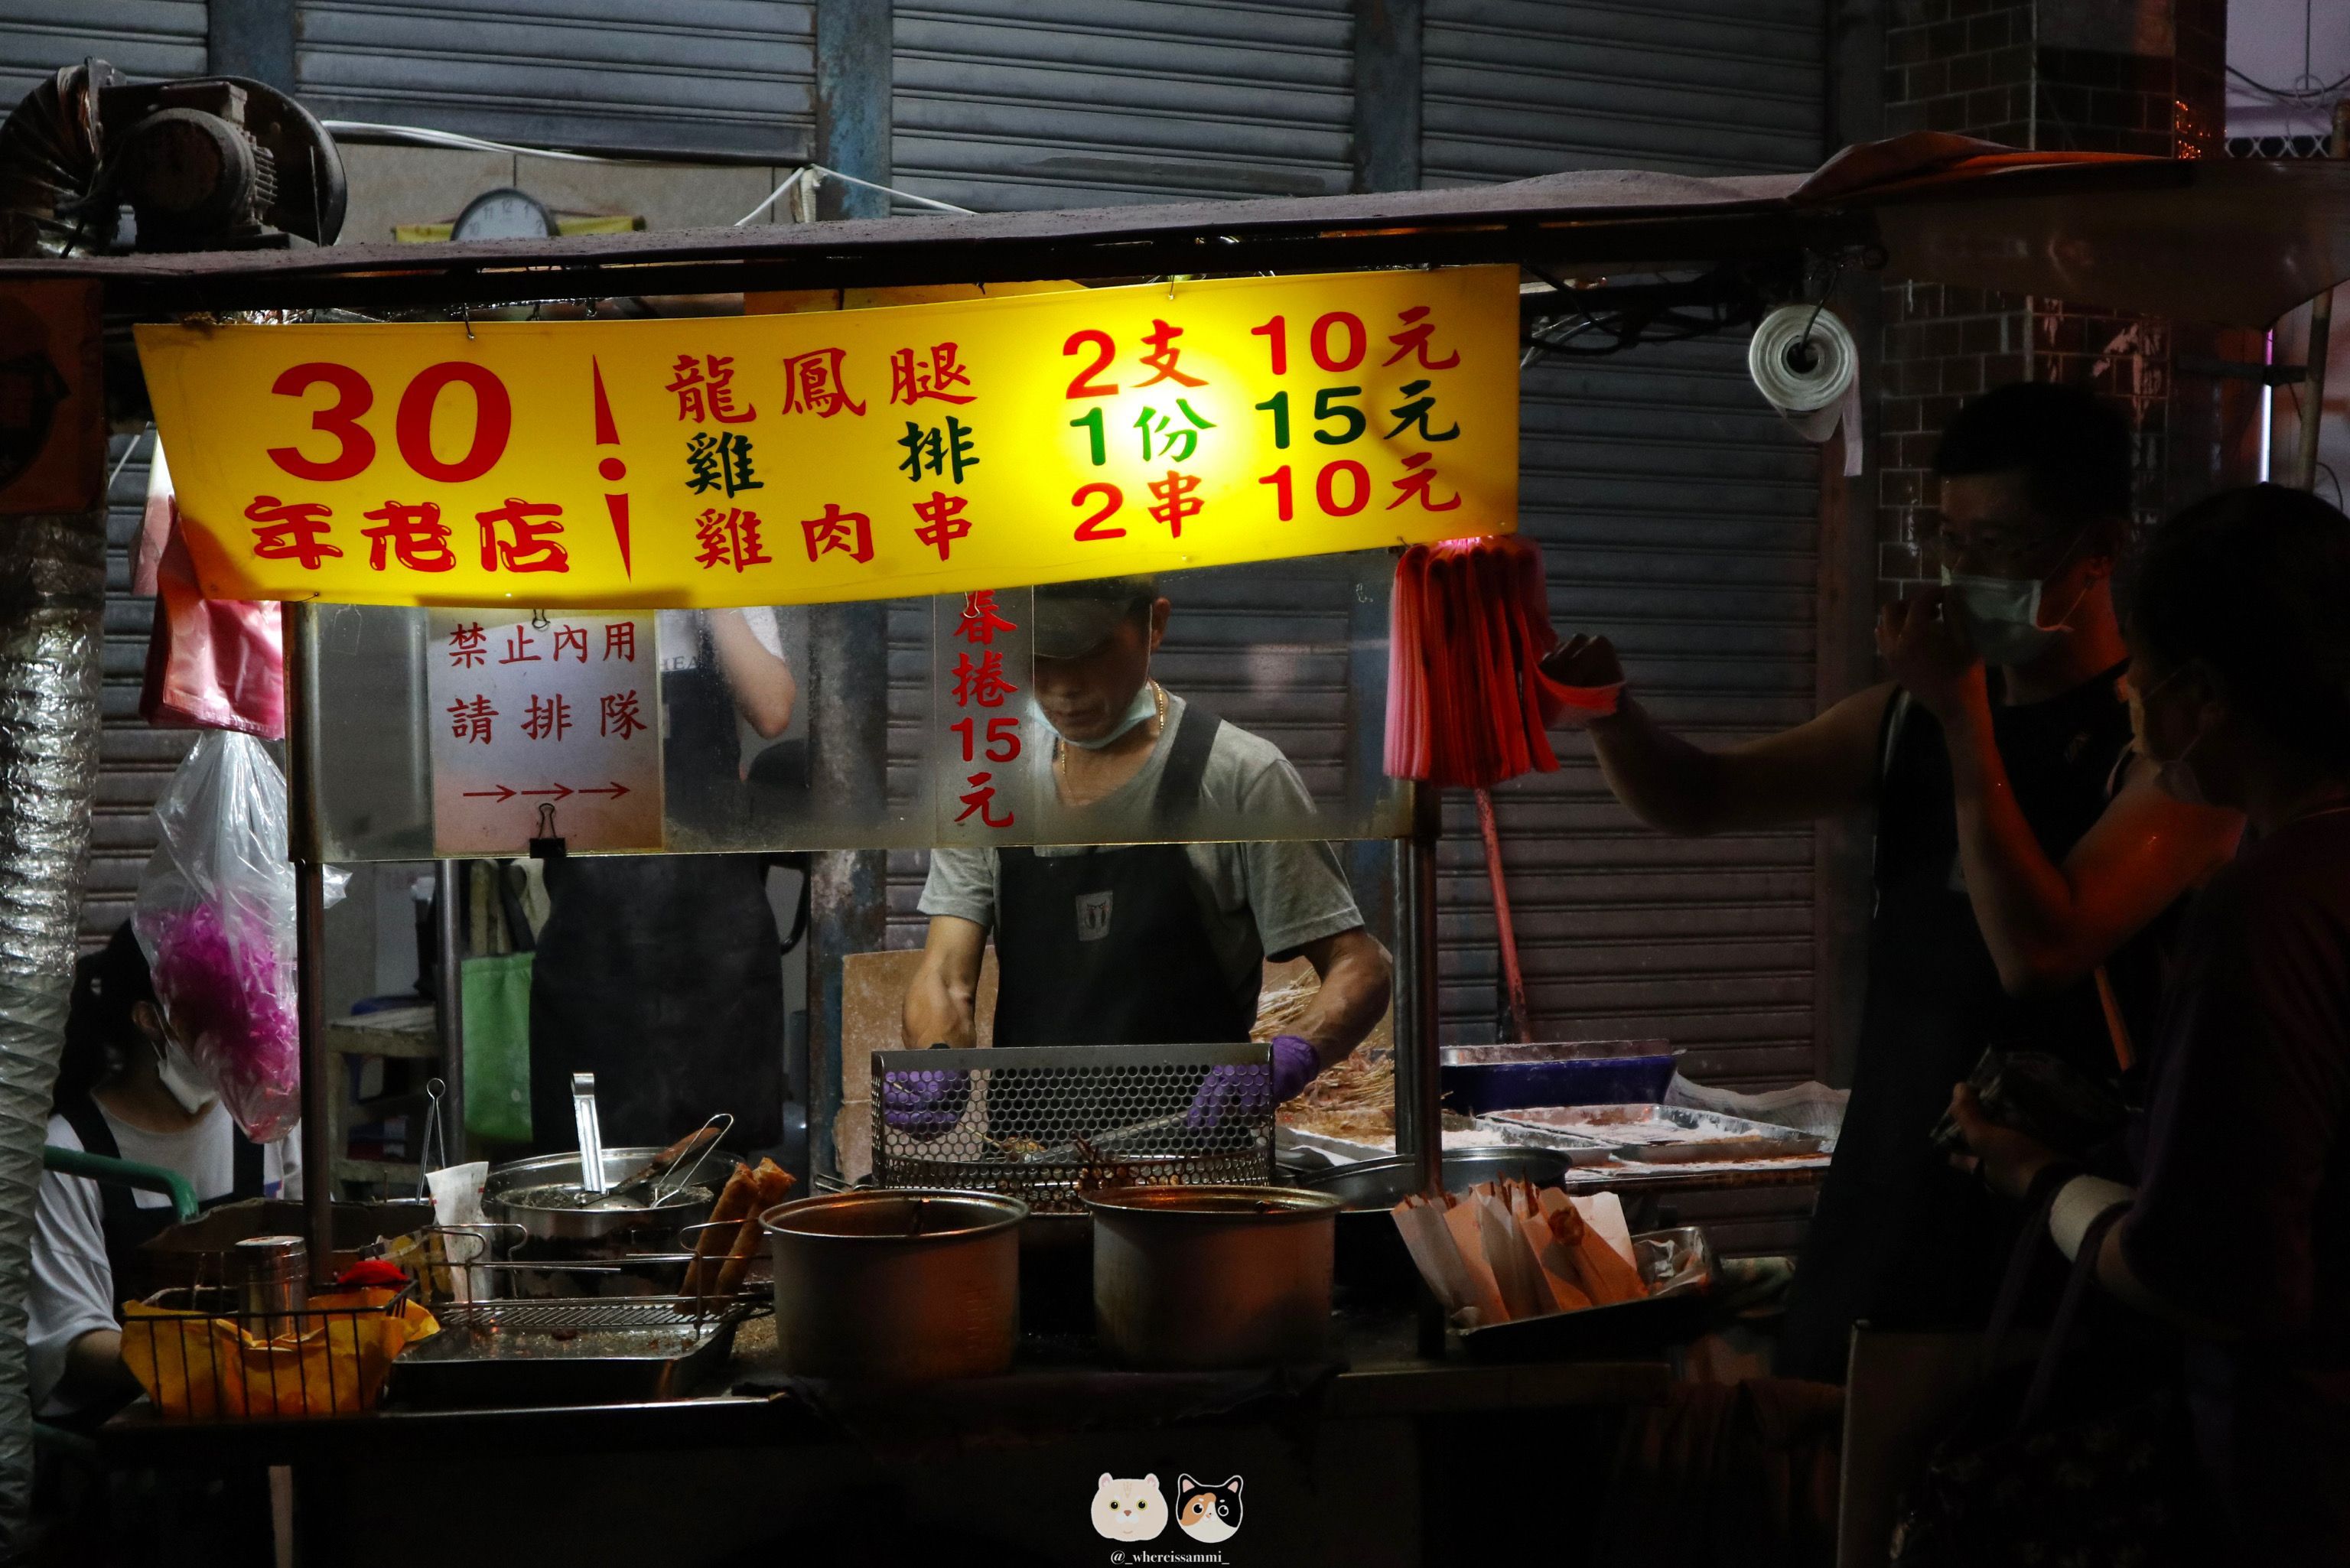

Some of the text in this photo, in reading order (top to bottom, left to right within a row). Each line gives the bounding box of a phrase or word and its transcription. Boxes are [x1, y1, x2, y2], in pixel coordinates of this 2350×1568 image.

[664, 305, 1461, 425] 龍鳳腿 2支 10元
[265, 361, 513, 483] 30
[1069, 398, 1217, 467] 1份
[1255, 379, 1461, 451] 15元
[243, 497, 571, 574] 年老店
[693, 451, 1462, 574] 雞肉串 2串 10元
[448, 621, 636, 669] 禁止內用
[447, 689, 648, 745] 請排隊
